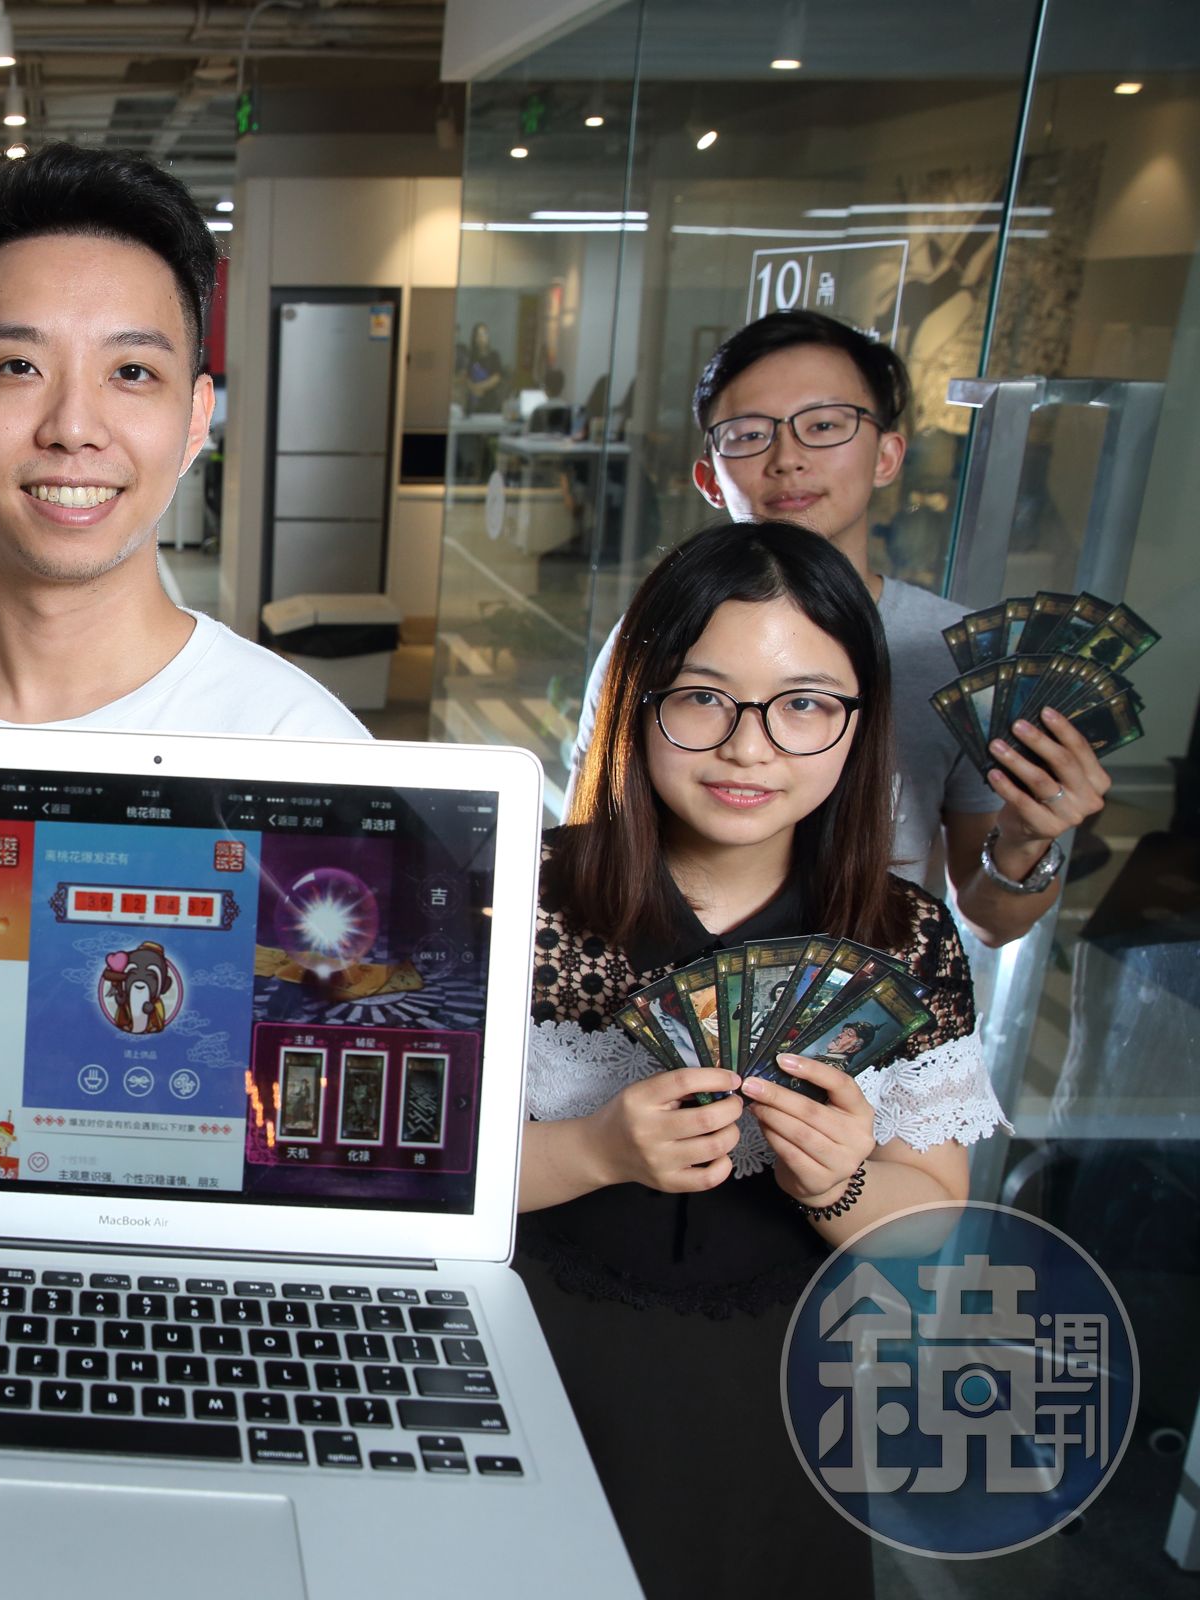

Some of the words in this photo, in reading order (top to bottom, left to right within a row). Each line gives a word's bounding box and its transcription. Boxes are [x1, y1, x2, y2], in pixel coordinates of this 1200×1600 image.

[757, 260, 802, 319] 10
[361, 818, 396, 832] 请选择
[430, 887, 448, 906] 吉
[286, 1147, 310, 1160] 天机
[99, 1215, 151, 1227] MacBook
[154, 1216, 169, 1227] Air
